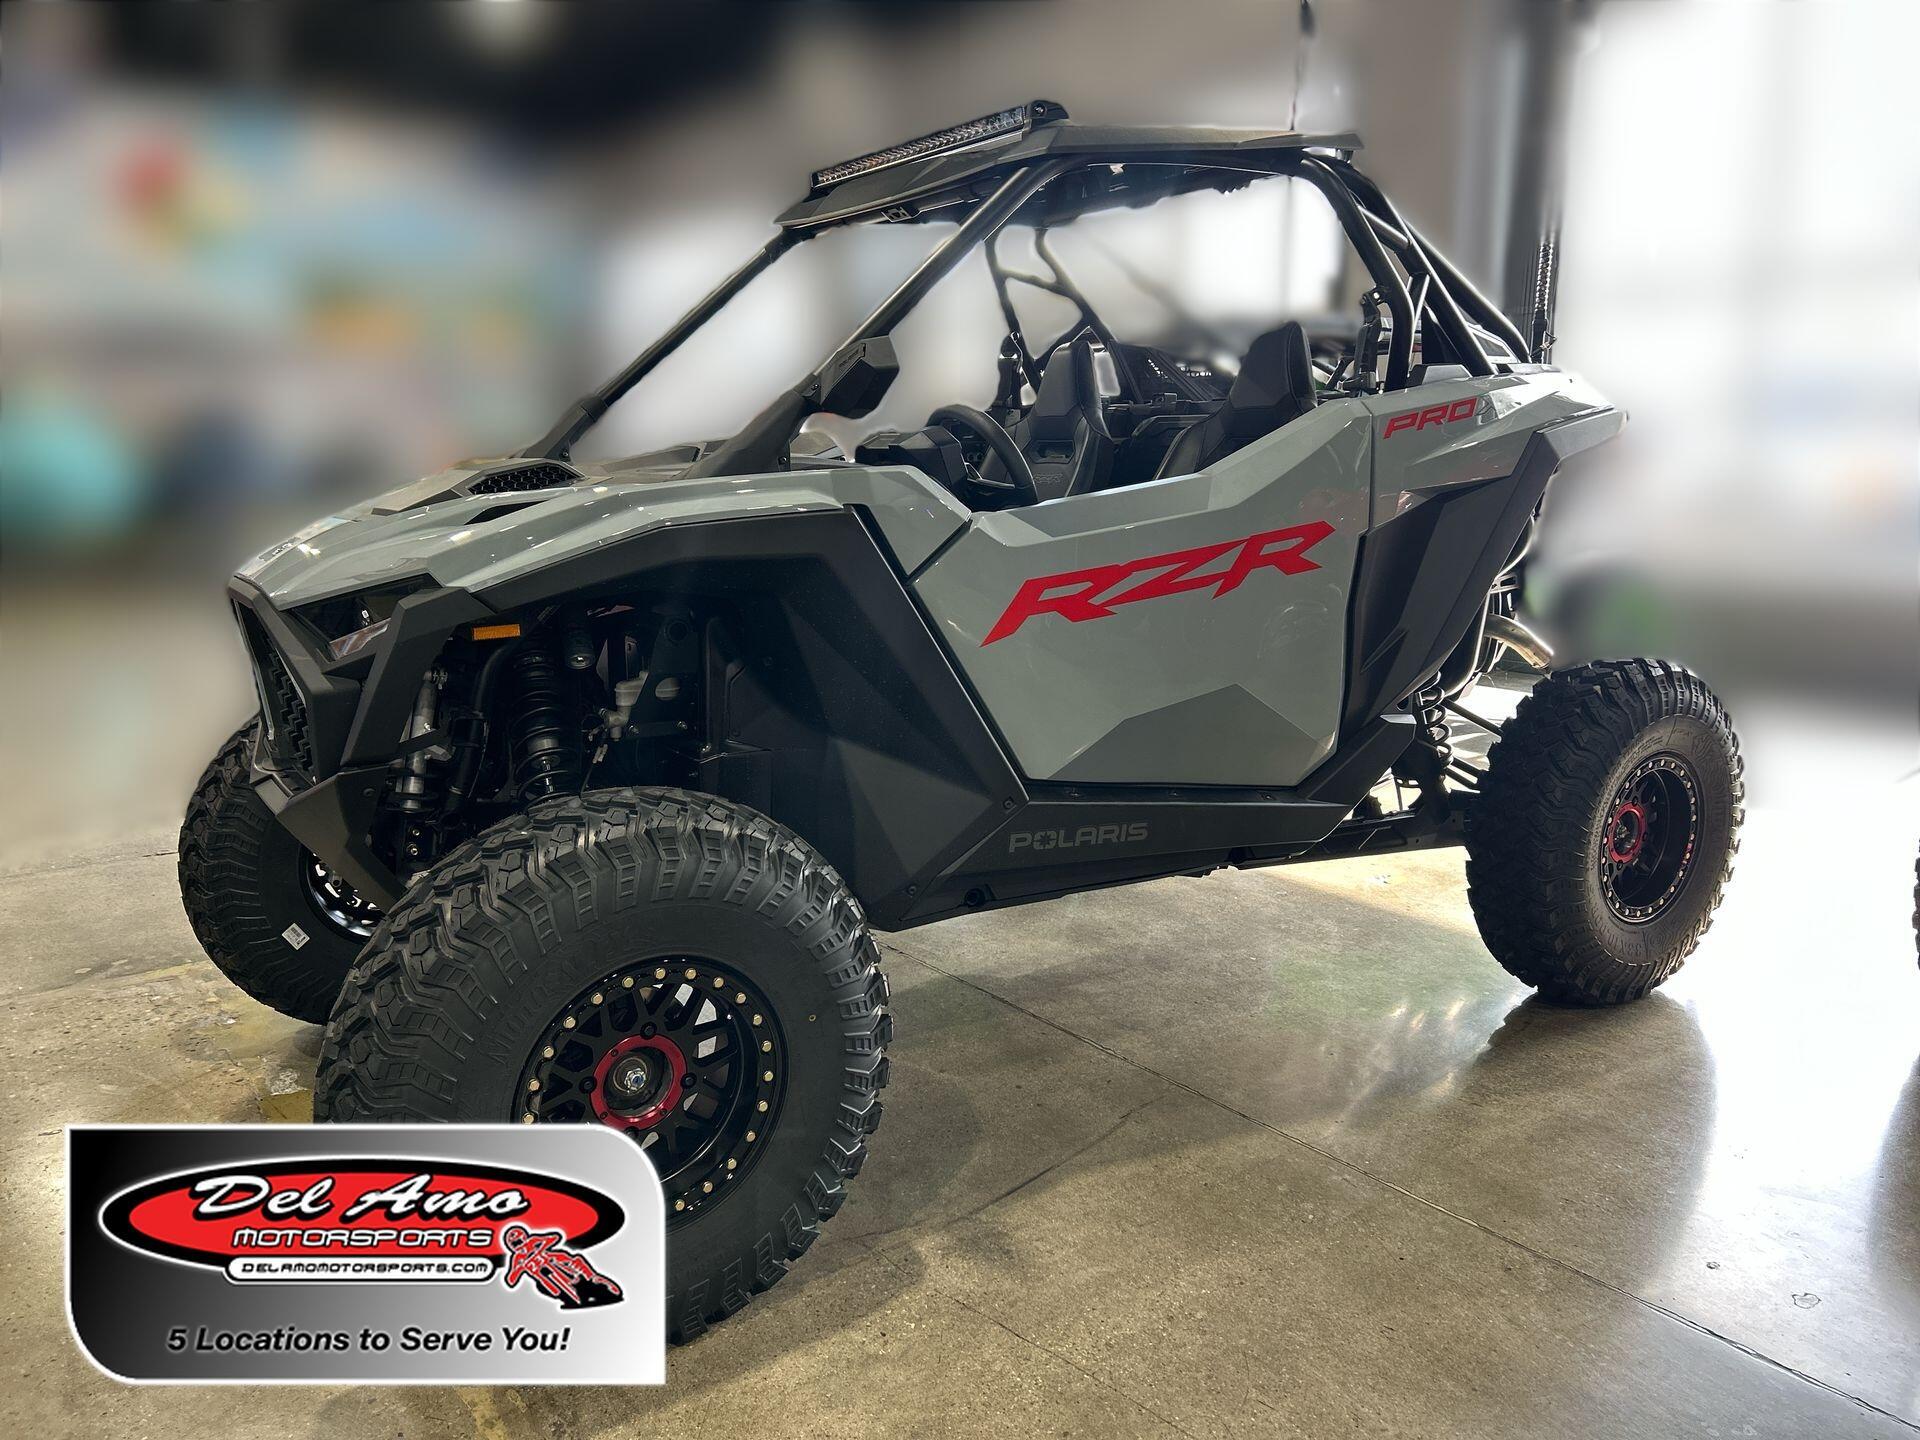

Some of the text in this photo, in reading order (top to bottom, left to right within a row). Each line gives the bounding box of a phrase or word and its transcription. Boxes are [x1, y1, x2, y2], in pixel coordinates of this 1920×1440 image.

[1384, 397, 1478, 439] PRO
[980, 520, 1336, 647] RZR
[1009, 823, 1149, 853] POLARIS
